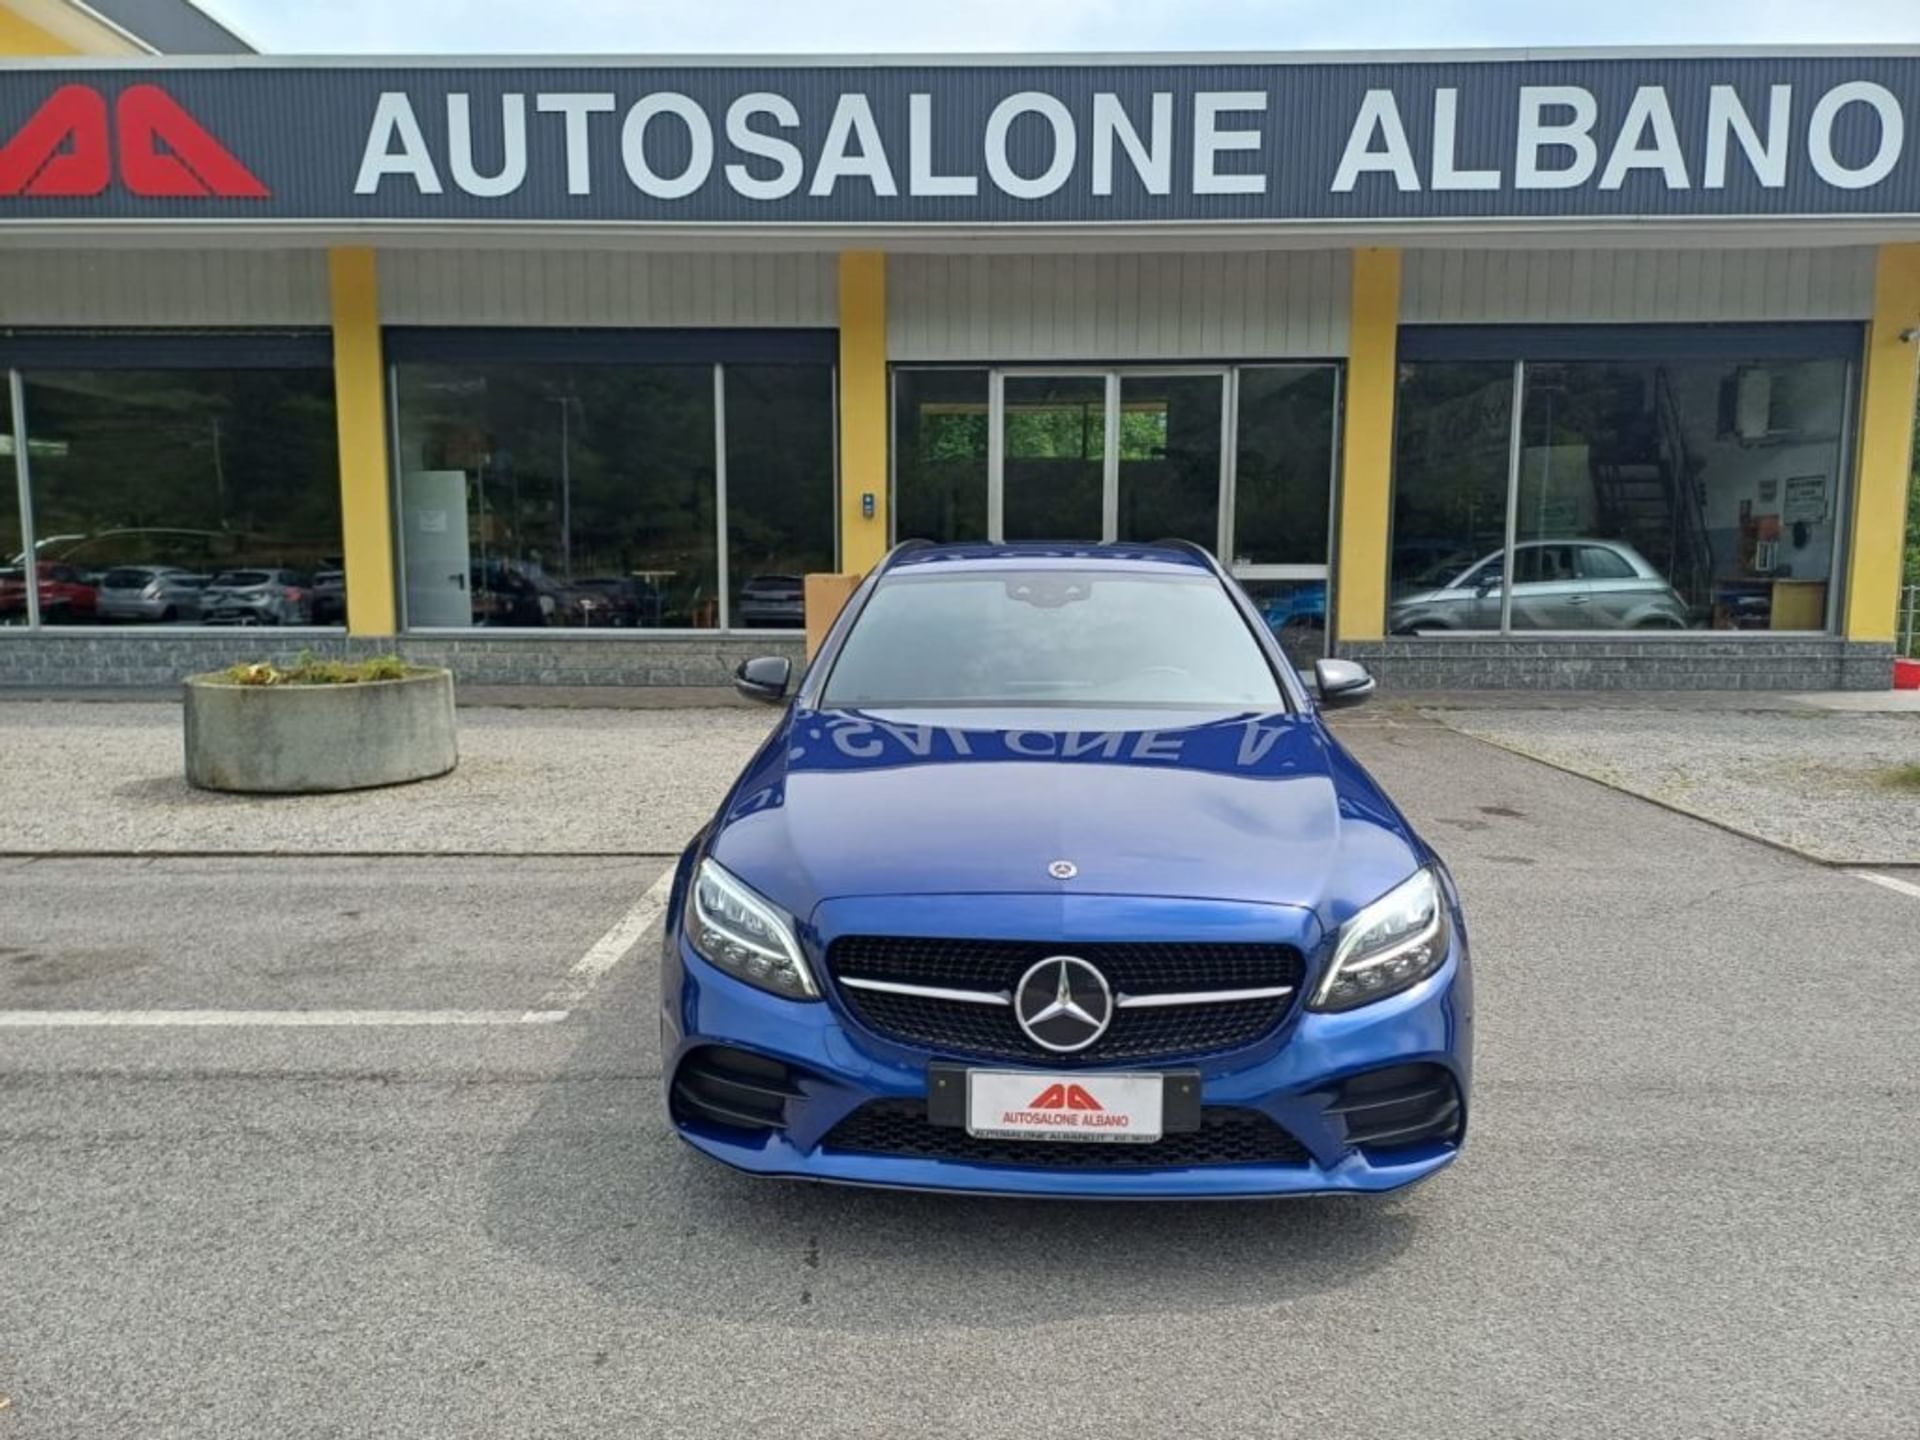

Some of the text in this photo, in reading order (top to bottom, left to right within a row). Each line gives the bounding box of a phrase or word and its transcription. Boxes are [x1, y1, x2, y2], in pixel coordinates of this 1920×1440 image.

[353, 80, 1904, 200] AUTOSALONE ALBANO
[1003, 1111, 1129, 1128] AUTOSALONE ALBANO
